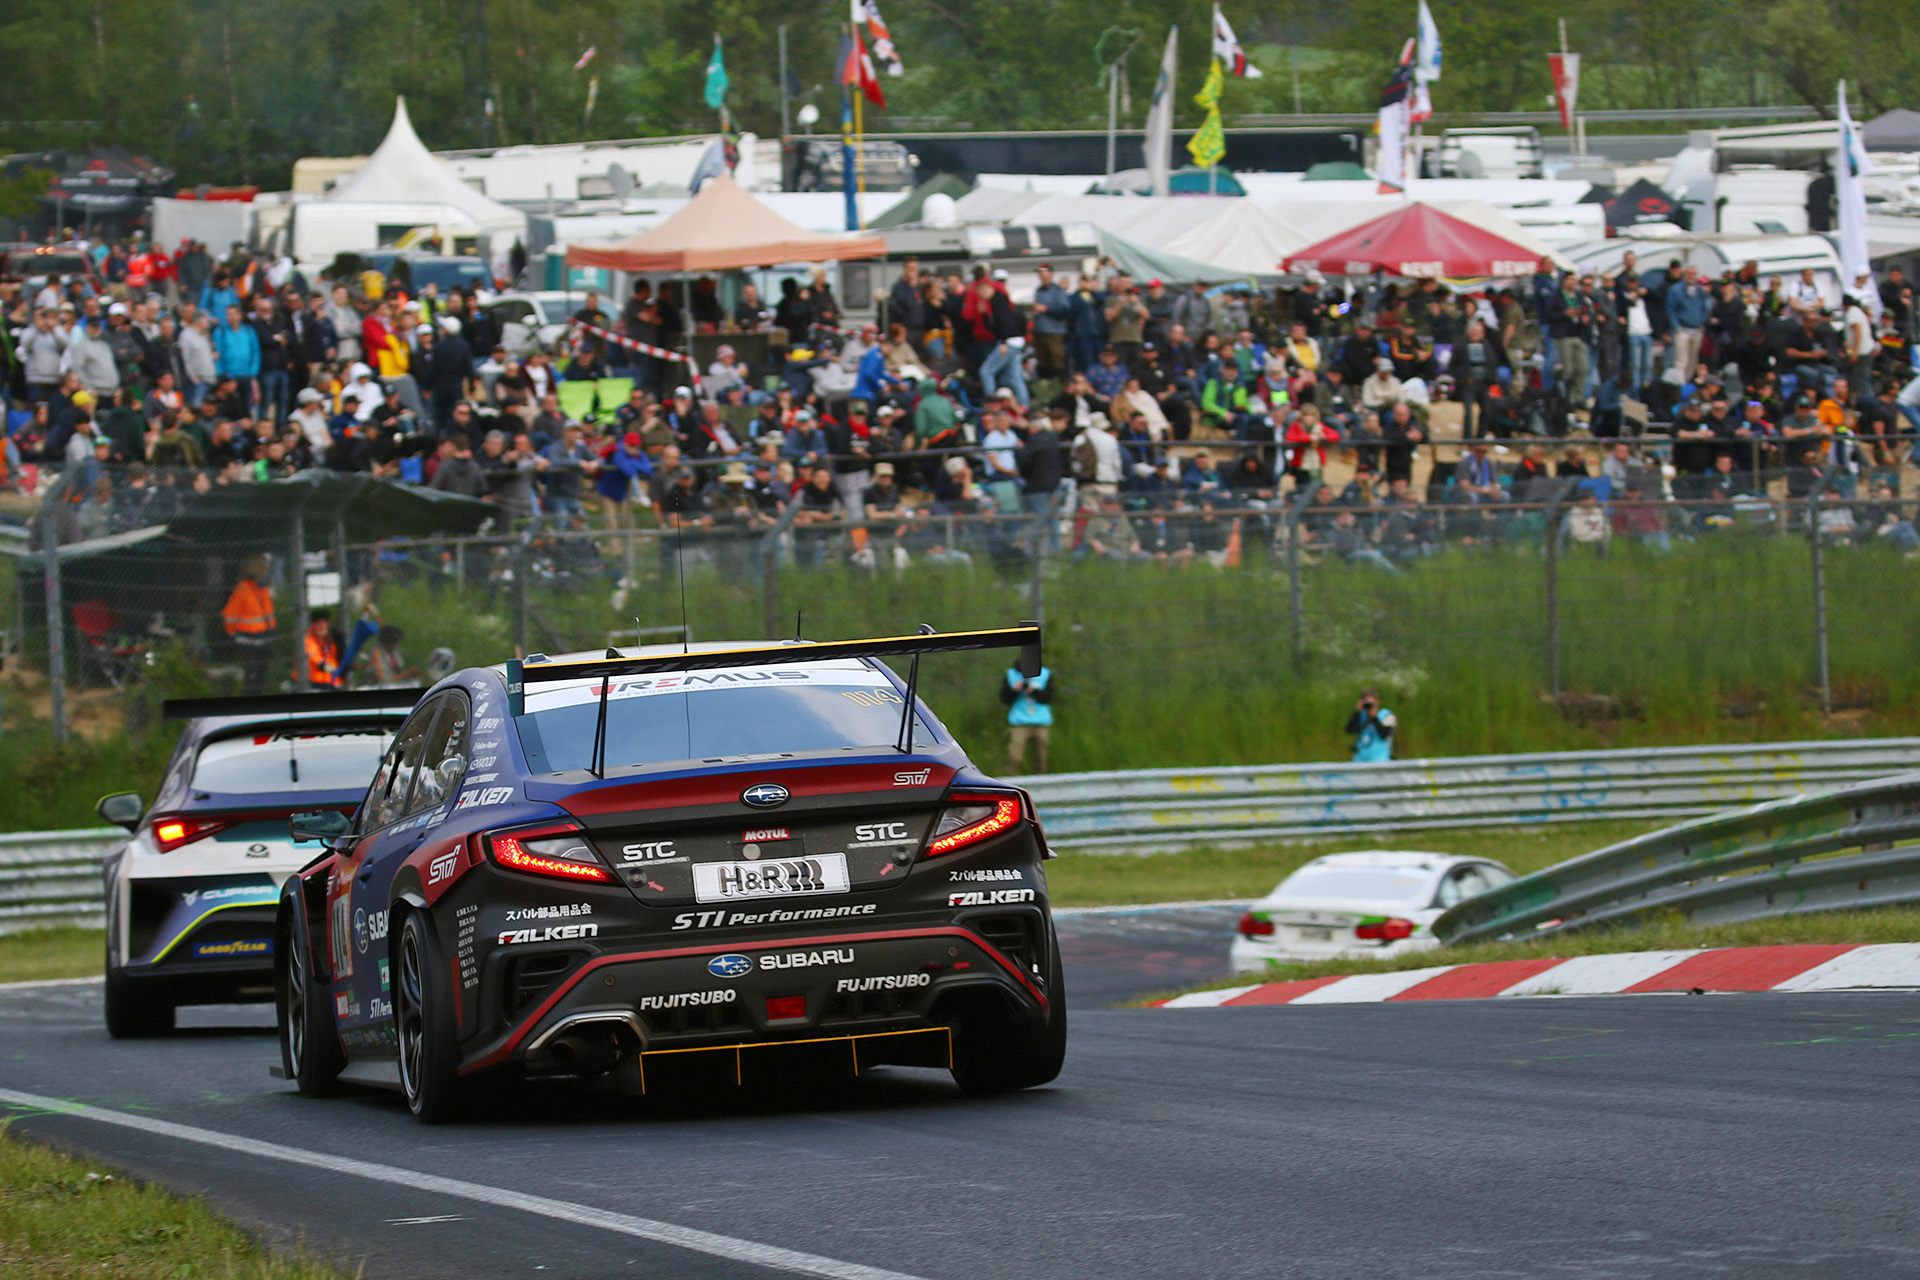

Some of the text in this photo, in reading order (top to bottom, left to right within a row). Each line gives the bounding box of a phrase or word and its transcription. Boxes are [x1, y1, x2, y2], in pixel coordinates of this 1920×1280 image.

[618, 670, 811, 692] REMUS
[618, 685, 703, 697] PERFORMANCE
[841, 688, 903, 707] 114
[454, 786, 514, 810] FALKEN
[744, 829, 788, 841] MOTUL
[855, 822, 908, 842] STC
[622, 841, 676, 861] STC
[949, 869, 1023, 881] スバル部品用品会
[202, 886, 273, 900] CUPRA
[948, 888, 1035, 906] FALKEN
[505, 903, 592, 921] スバル部品用品会
[672, 903, 877, 930] STI Performance
[497, 923, 598, 944] FALKEN
[199, 941, 267, 955] GOODYEAR
[759, 949, 854, 970] SUBARU
[836, 973, 931, 993] FUJITSUBO
[640, 989, 736, 1010] FUJITSUBO
